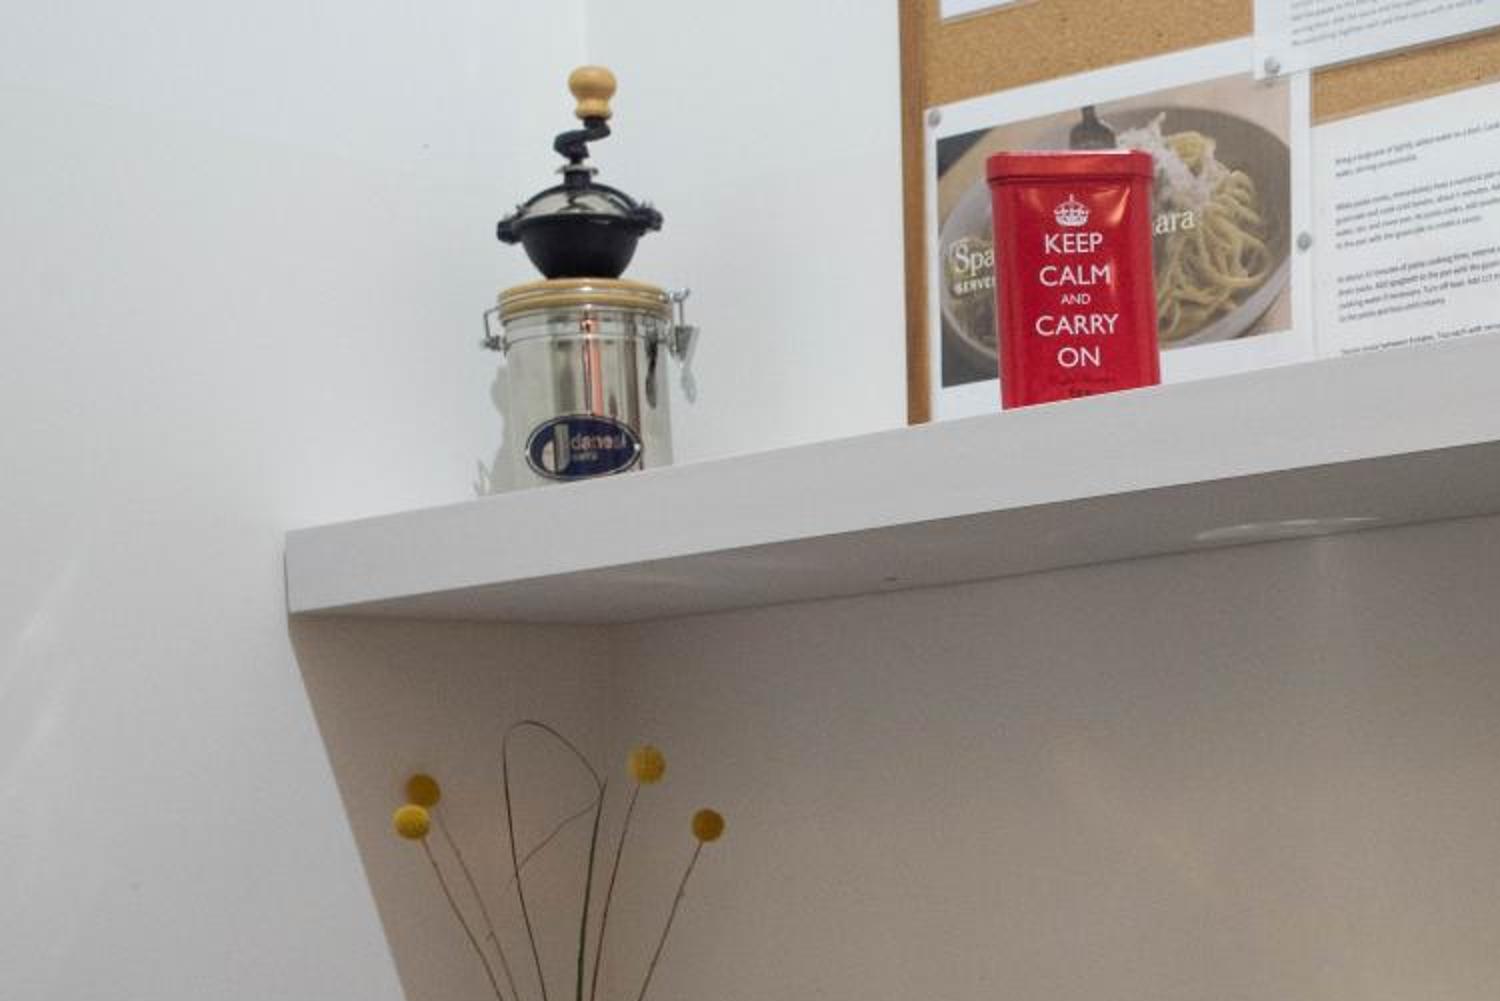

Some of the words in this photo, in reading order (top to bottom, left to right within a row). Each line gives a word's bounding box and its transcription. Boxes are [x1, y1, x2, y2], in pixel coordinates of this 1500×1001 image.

[1044, 232, 1103, 254] KEEP
[1039, 264, 1112, 287] CALM
[1060, 292, 1091, 305] AND
[1035, 313, 1119, 336] CARRY
[1057, 345, 1100, 368] ON
